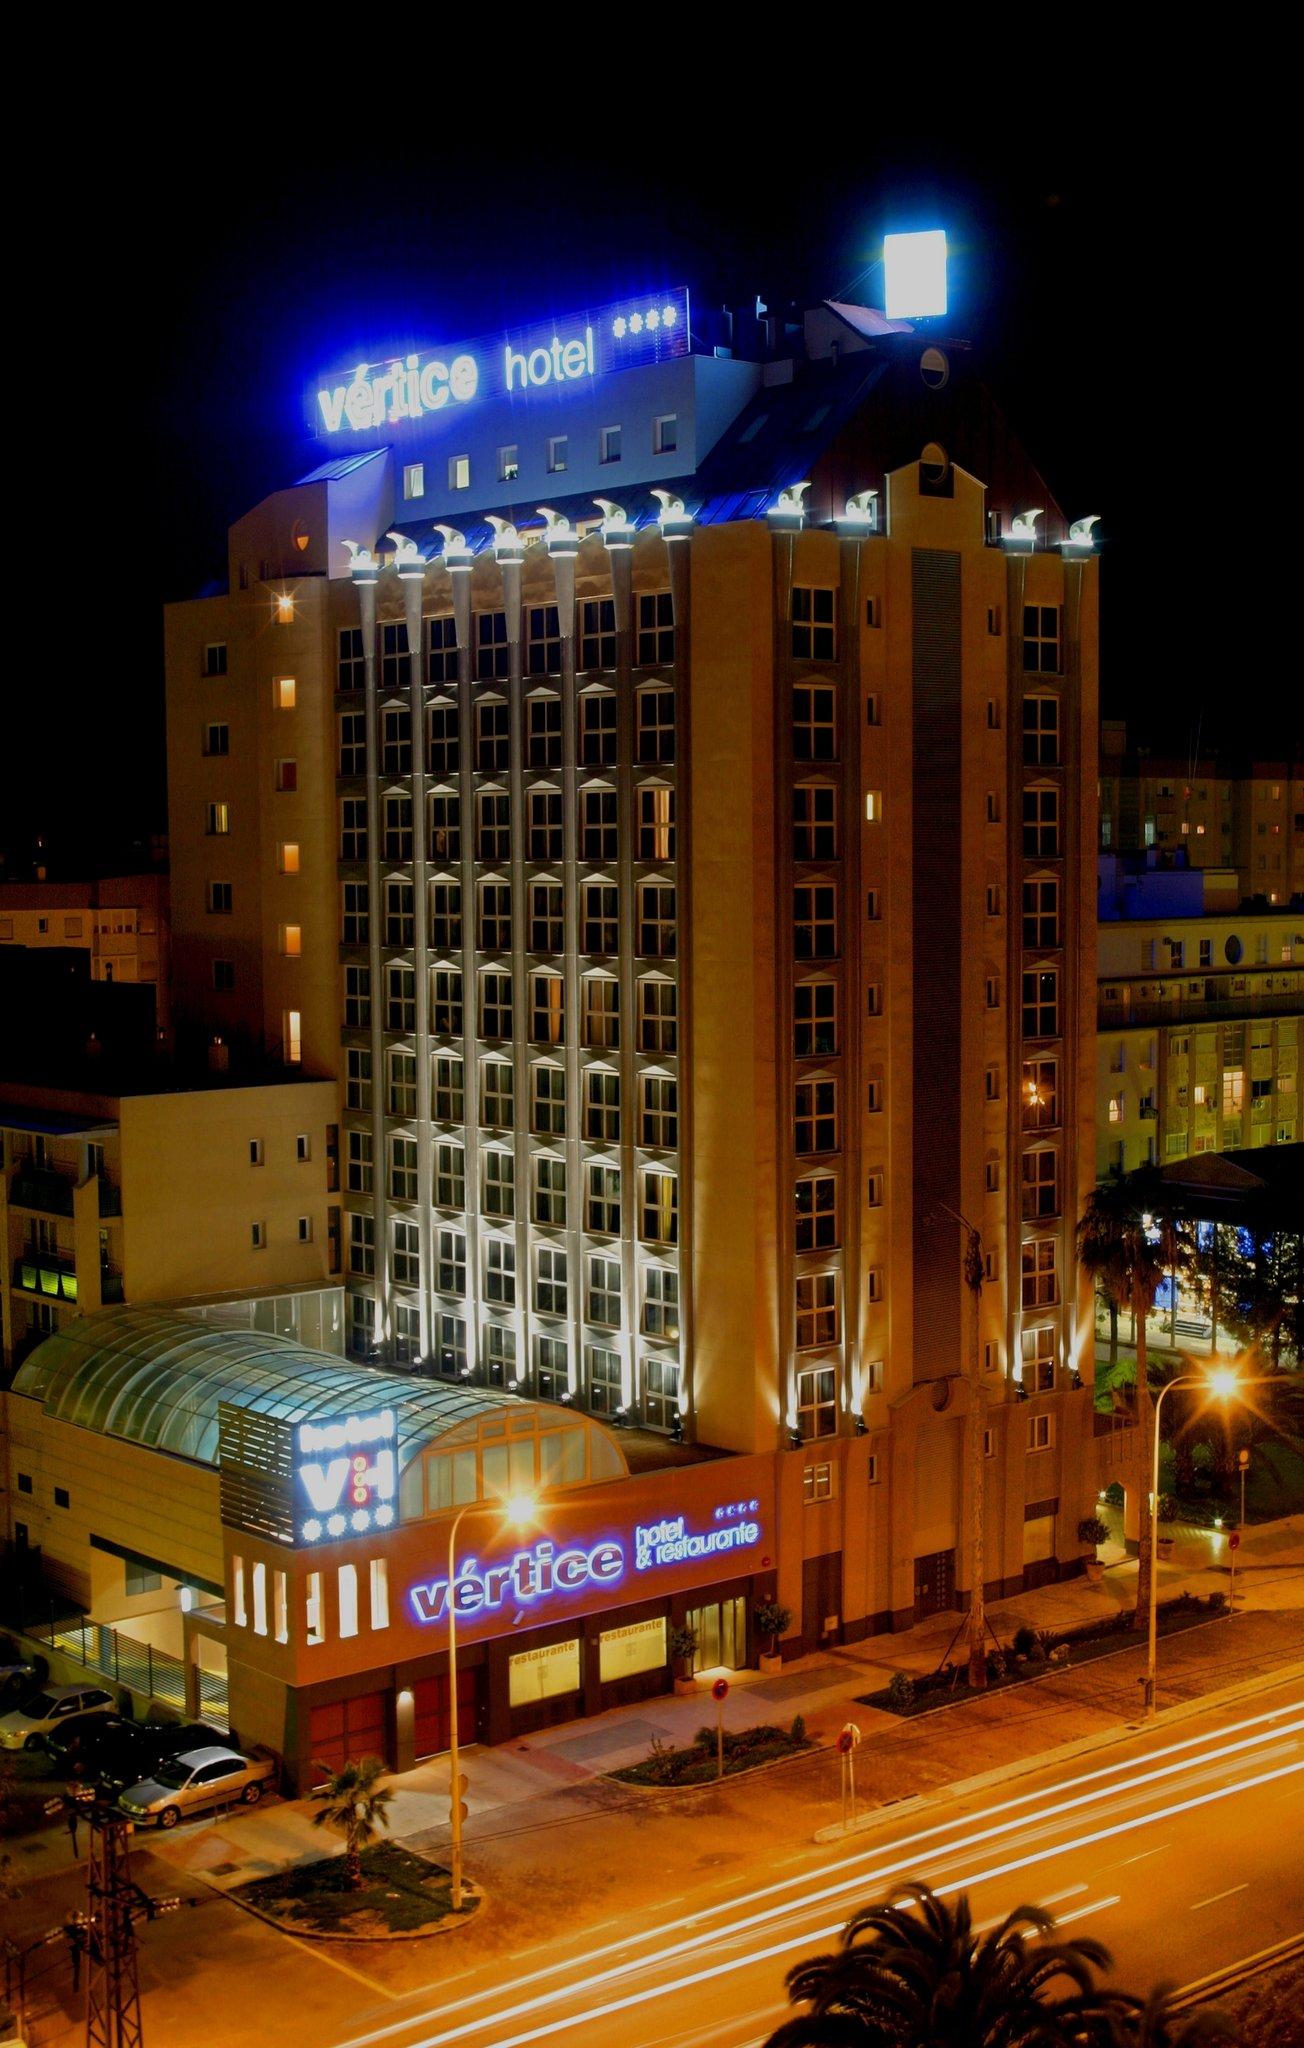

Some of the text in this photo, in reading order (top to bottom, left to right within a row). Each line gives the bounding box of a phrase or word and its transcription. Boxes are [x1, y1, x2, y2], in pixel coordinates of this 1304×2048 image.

[317, 326, 594, 432] vértice hotel
[635, 1516, 684, 1547] hotel
[655, 1521, 760, 1564] restaurante
[410, 1542, 624, 1623] vértice
[600, 1619, 662, 1643] restaurante
[509, 1641, 575, 1667] restaurante
